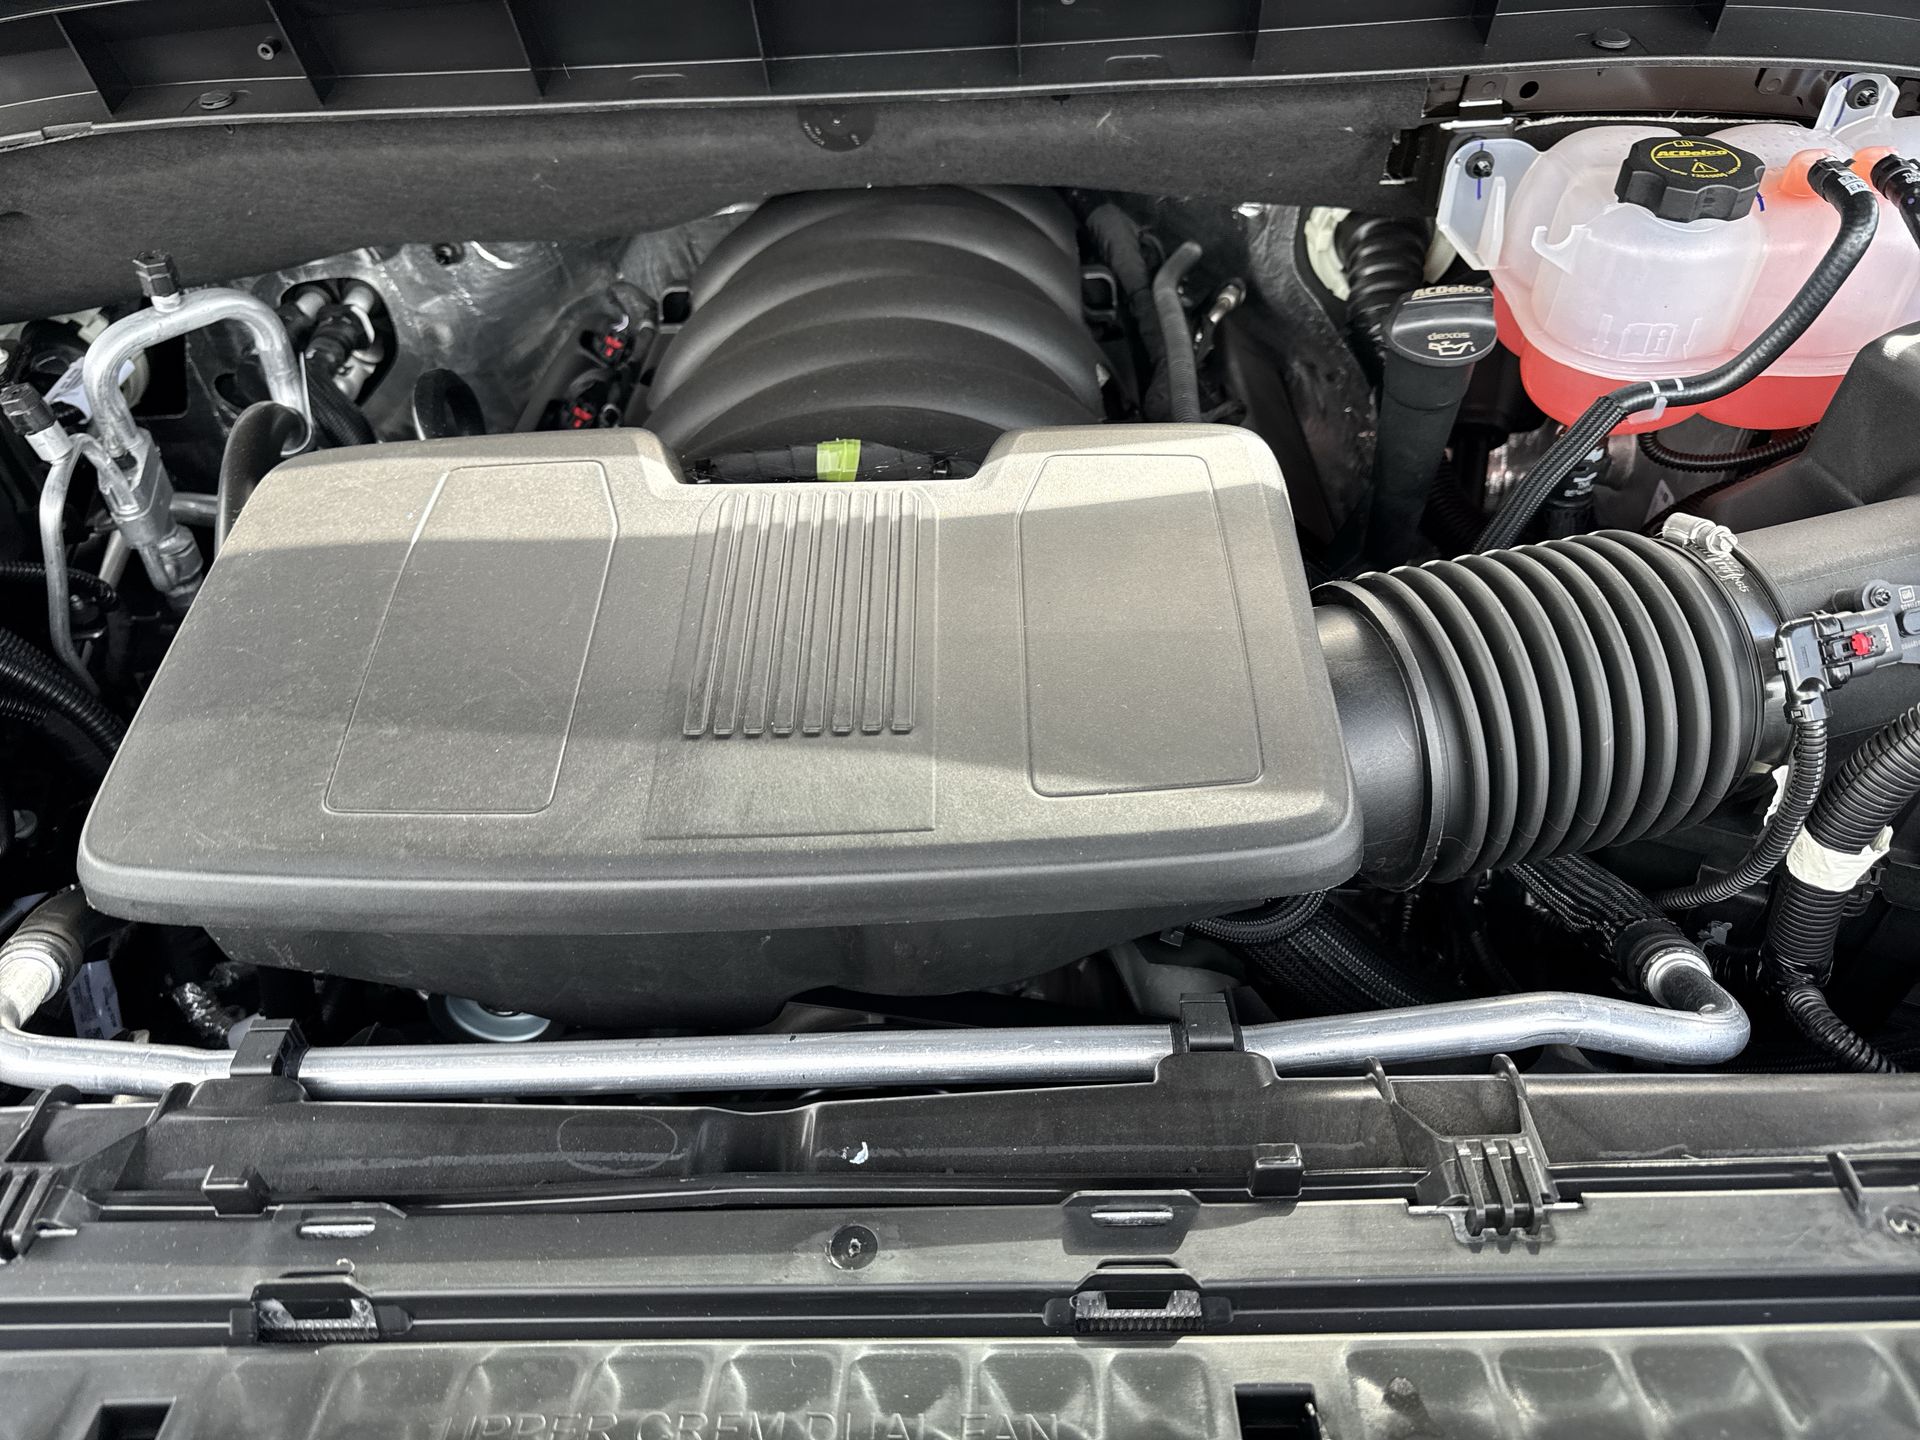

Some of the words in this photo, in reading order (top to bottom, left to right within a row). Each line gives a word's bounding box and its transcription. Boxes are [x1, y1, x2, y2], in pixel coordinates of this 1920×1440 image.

[1656, 149, 1728, 158] ACDelco
[1412, 285, 1485, 299] ACDelco
[1427, 332, 1471, 340] dexos
[440, 1412, 618, 1440] UPPER
